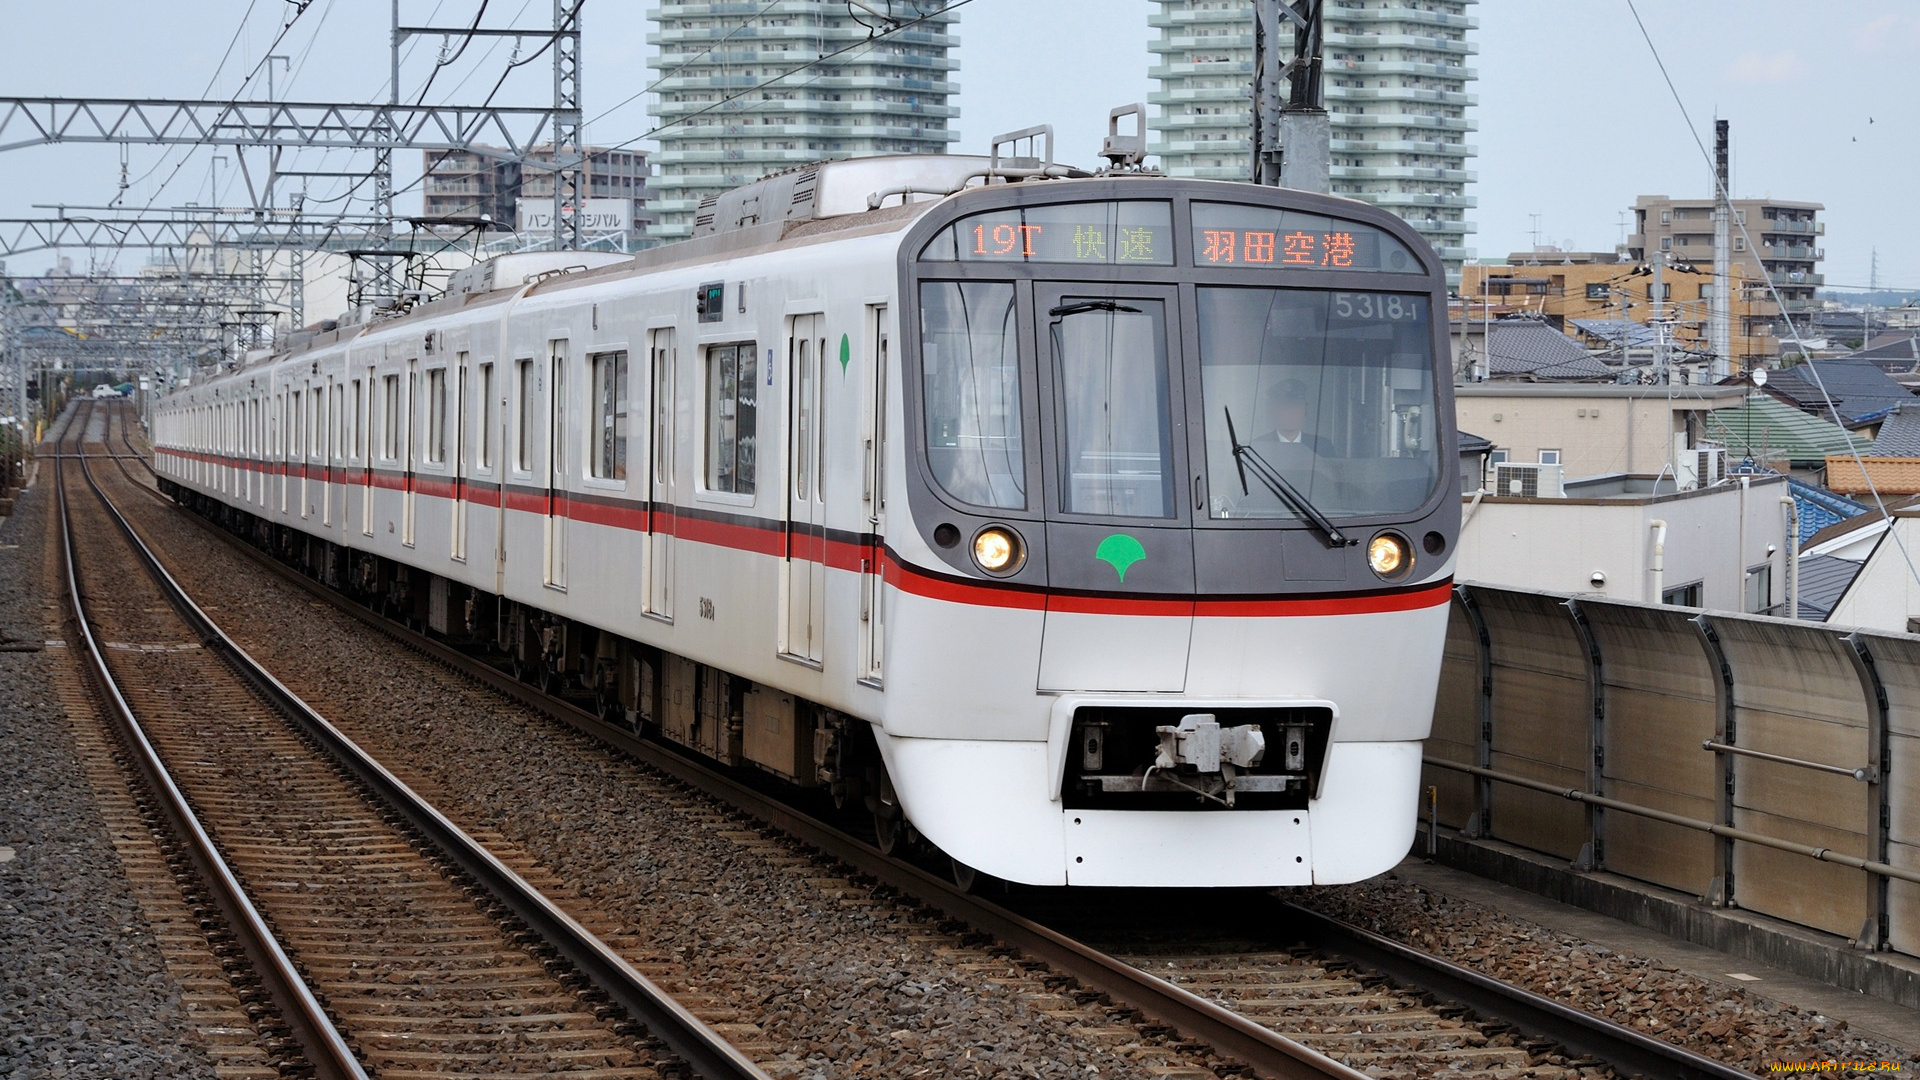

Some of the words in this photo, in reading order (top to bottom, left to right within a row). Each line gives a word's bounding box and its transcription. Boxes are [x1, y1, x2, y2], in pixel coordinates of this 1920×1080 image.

[529, 214, 620, 228] バンロジパル
[973, 224, 1042, 255] 19T
[1072, 225, 1154, 260] 快速
[1203, 230, 1355, 267] 羽田空港
[1335, 293, 1417, 320] 5318-1
